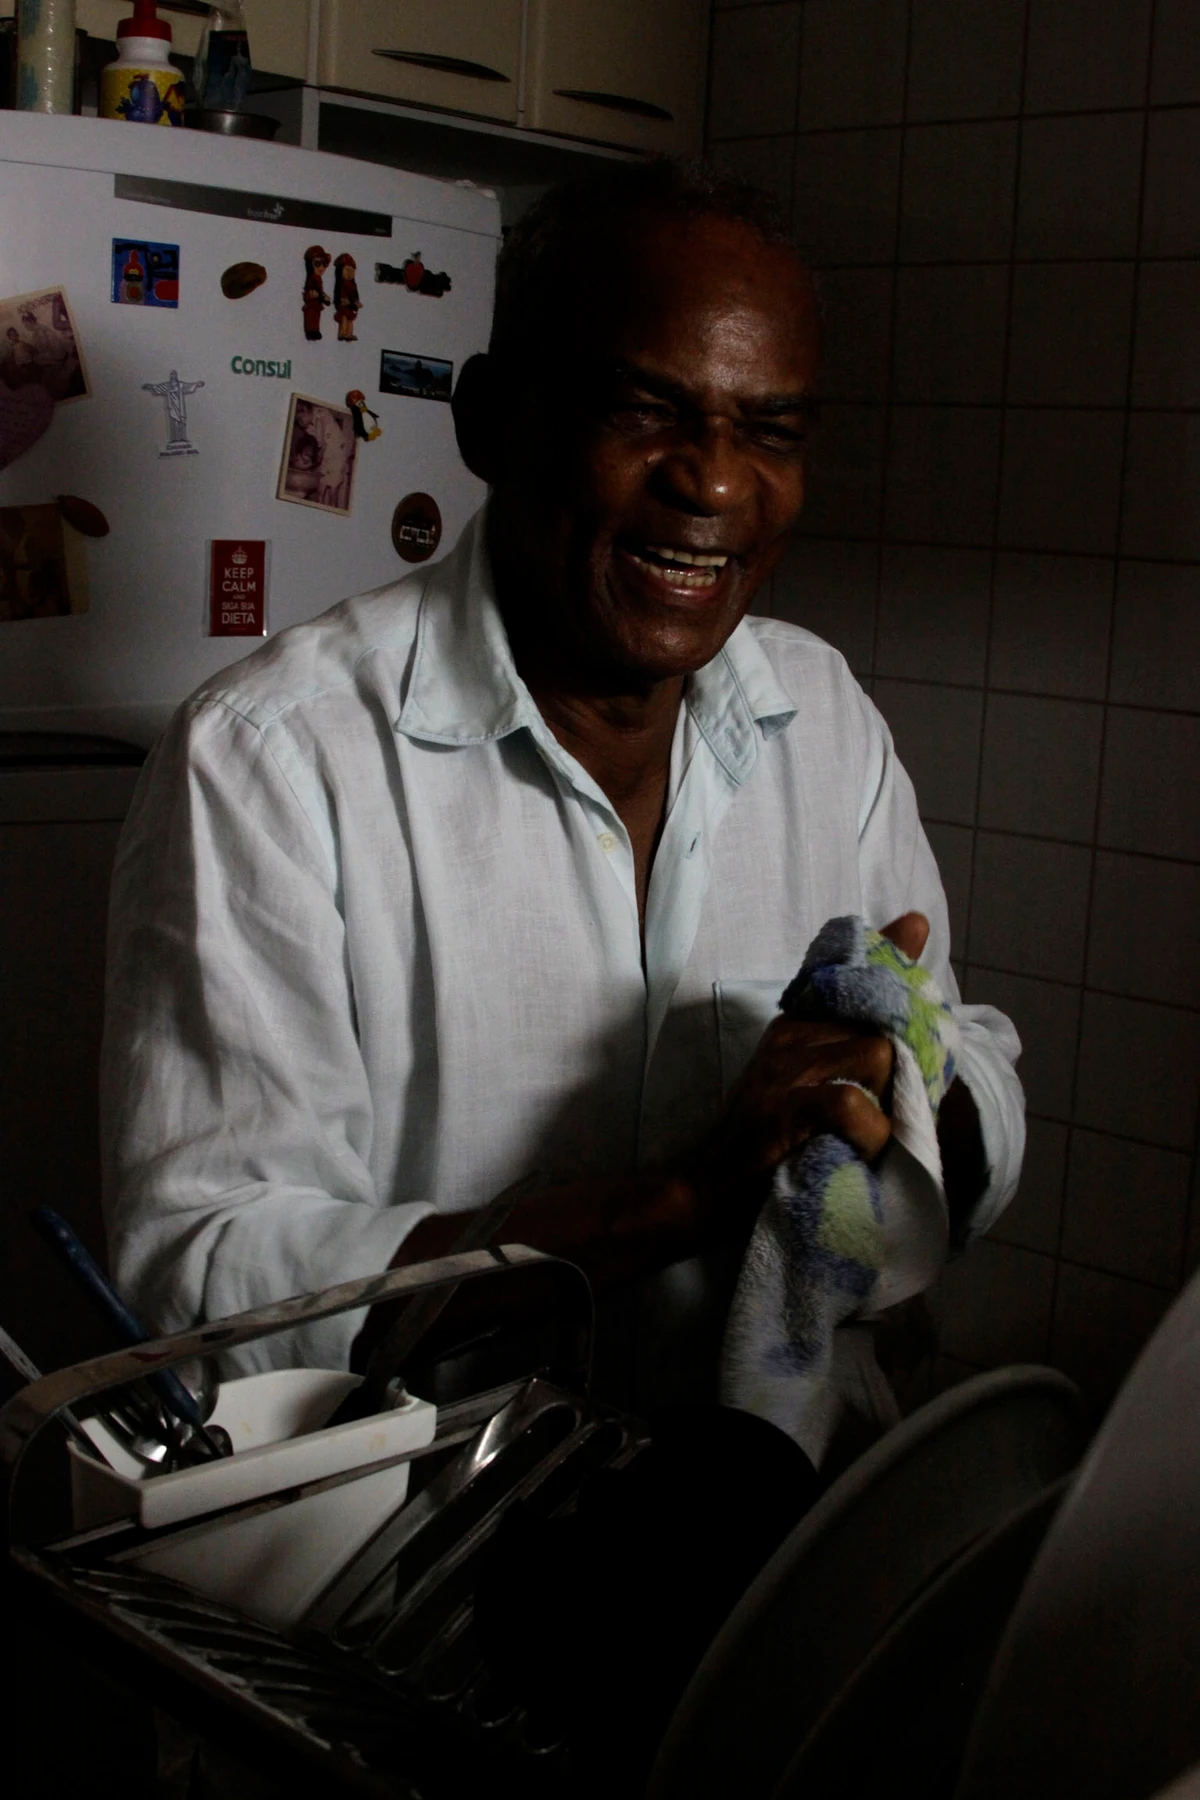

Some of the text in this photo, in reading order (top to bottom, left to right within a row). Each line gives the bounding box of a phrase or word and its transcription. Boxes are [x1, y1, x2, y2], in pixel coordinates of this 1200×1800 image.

[231, 356, 291, 379] Consul
[224, 567, 254, 579] KEEP
[222, 580, 256, 592] CALM
[221, 601, 255, 610] SIGA SUA
[221, 612, 256, 624] DIETA
